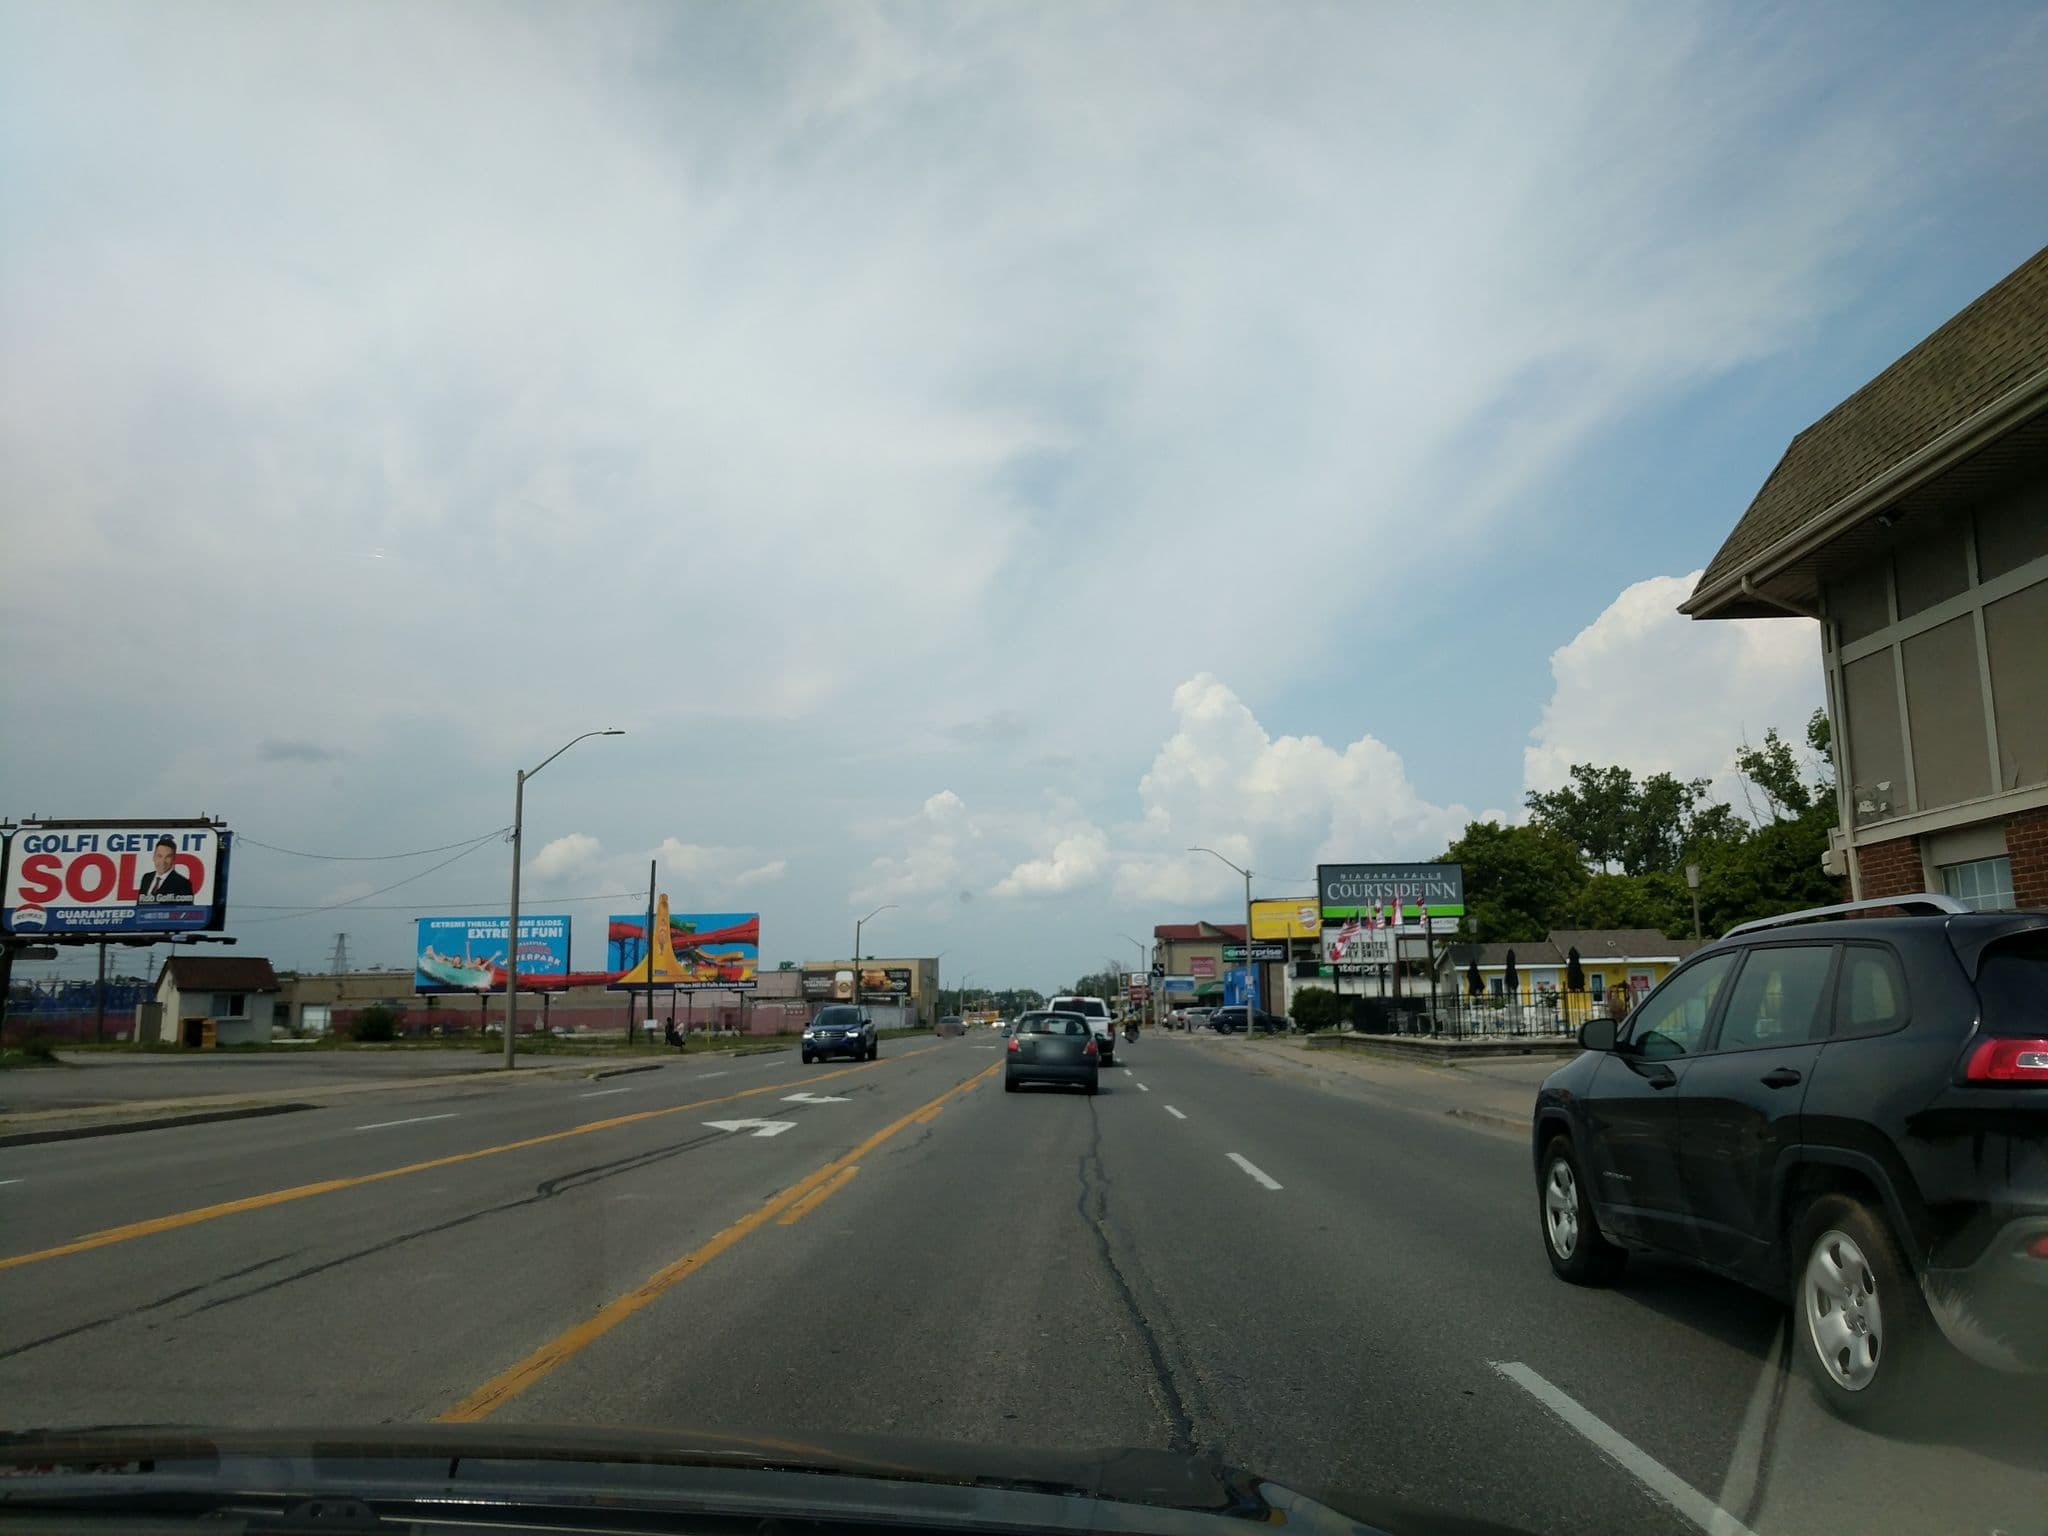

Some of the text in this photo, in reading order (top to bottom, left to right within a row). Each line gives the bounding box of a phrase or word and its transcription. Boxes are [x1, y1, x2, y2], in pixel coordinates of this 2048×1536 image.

[23, 834, 99, 853] GOLFI
[182, 833, 207, 852] IT
[1340, 871, 1441, 880] NIAGARA FALLS
[1327, 881, 1457, 900] COURTSIDE INN
[156, 893, 193, 902] Golfi.com
[56, 909, 135, 919] GUARANTEED
[501, 920, 536, 928] EXEME
[531, 926, 563, 938] FUN!
[1224, 948, 1282, 957] entrprise
[500, 952, 562, 967] WTERPARK
